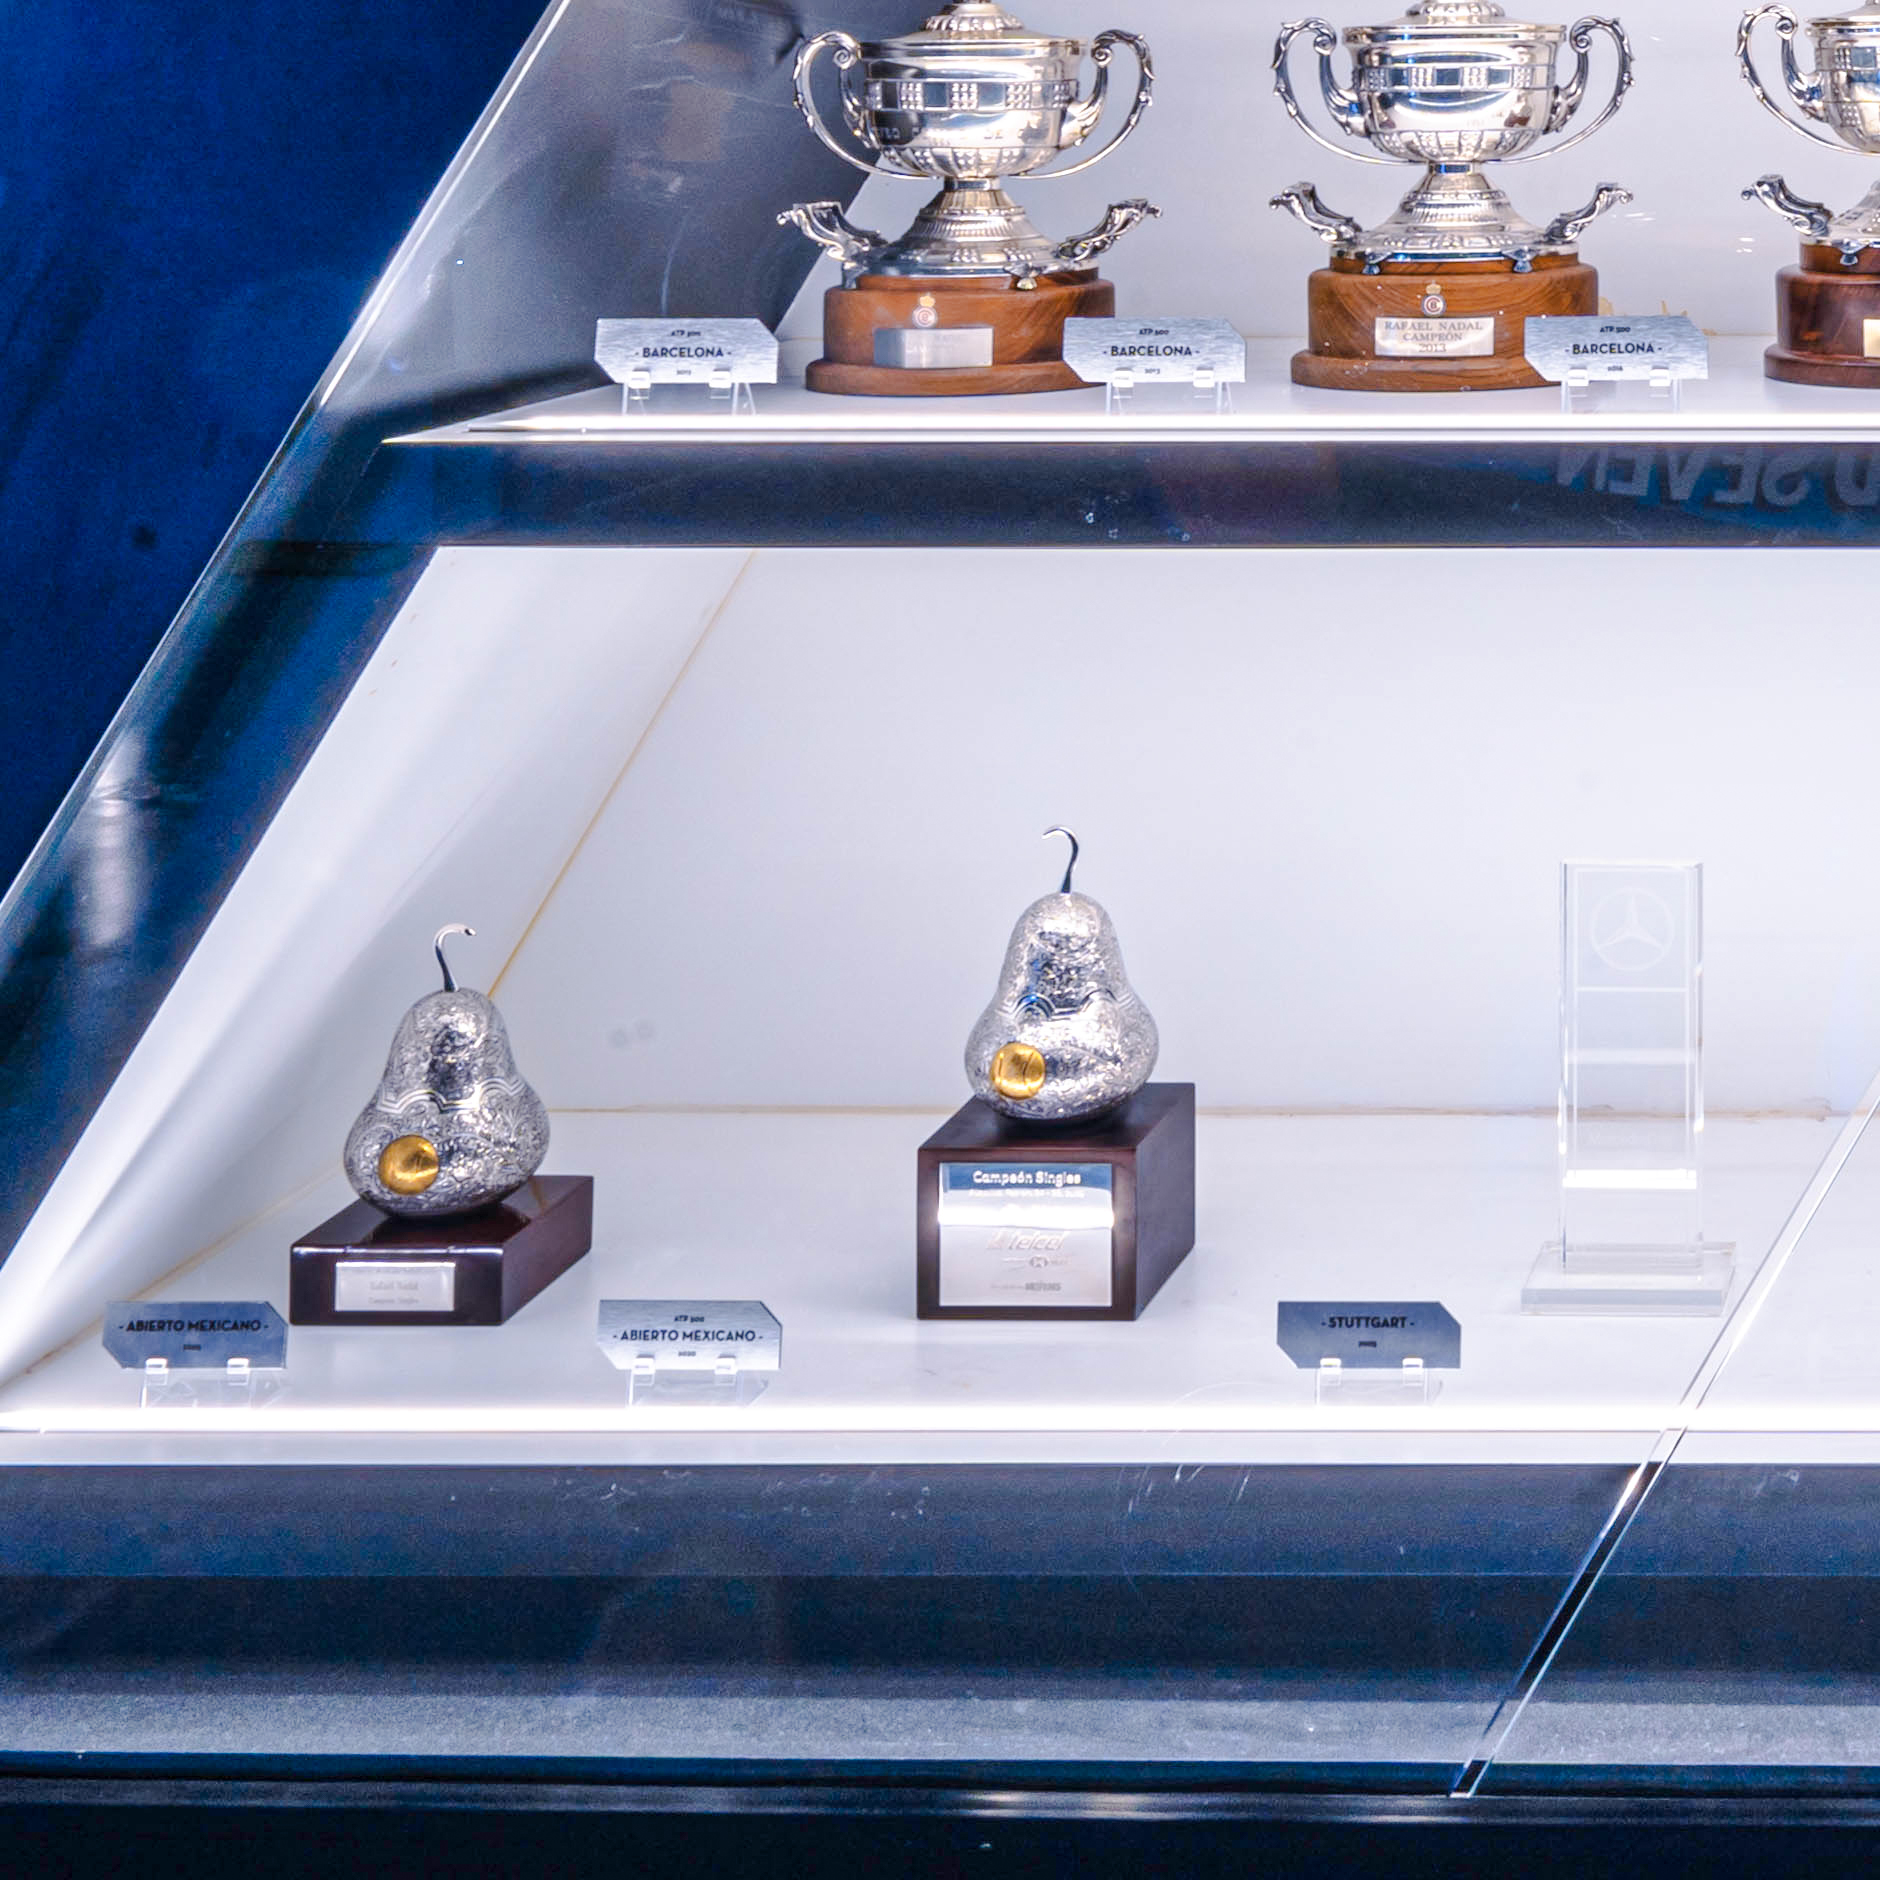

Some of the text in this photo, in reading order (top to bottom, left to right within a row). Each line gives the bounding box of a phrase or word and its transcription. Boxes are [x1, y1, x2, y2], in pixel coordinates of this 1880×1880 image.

[1384, 321, 1483, 331] RAFAEL NADAL
[1403, 331, 1463, 341] CAMPEÓN
[643, 347, 723, 357] BARCELONA
[1111, 346, 1192, 356] BARCELONA
[1418, 343, 1447, 352] 2013
[1572, 343, 1654, 354] BARCELONA
[127, 1320, 261, 1331] ABIERTO MEXICANO
[1328, 1316, 1407, 1329] STUTTGART
[621, 1330, 756, 1342] ABIERTO MEXICANO
